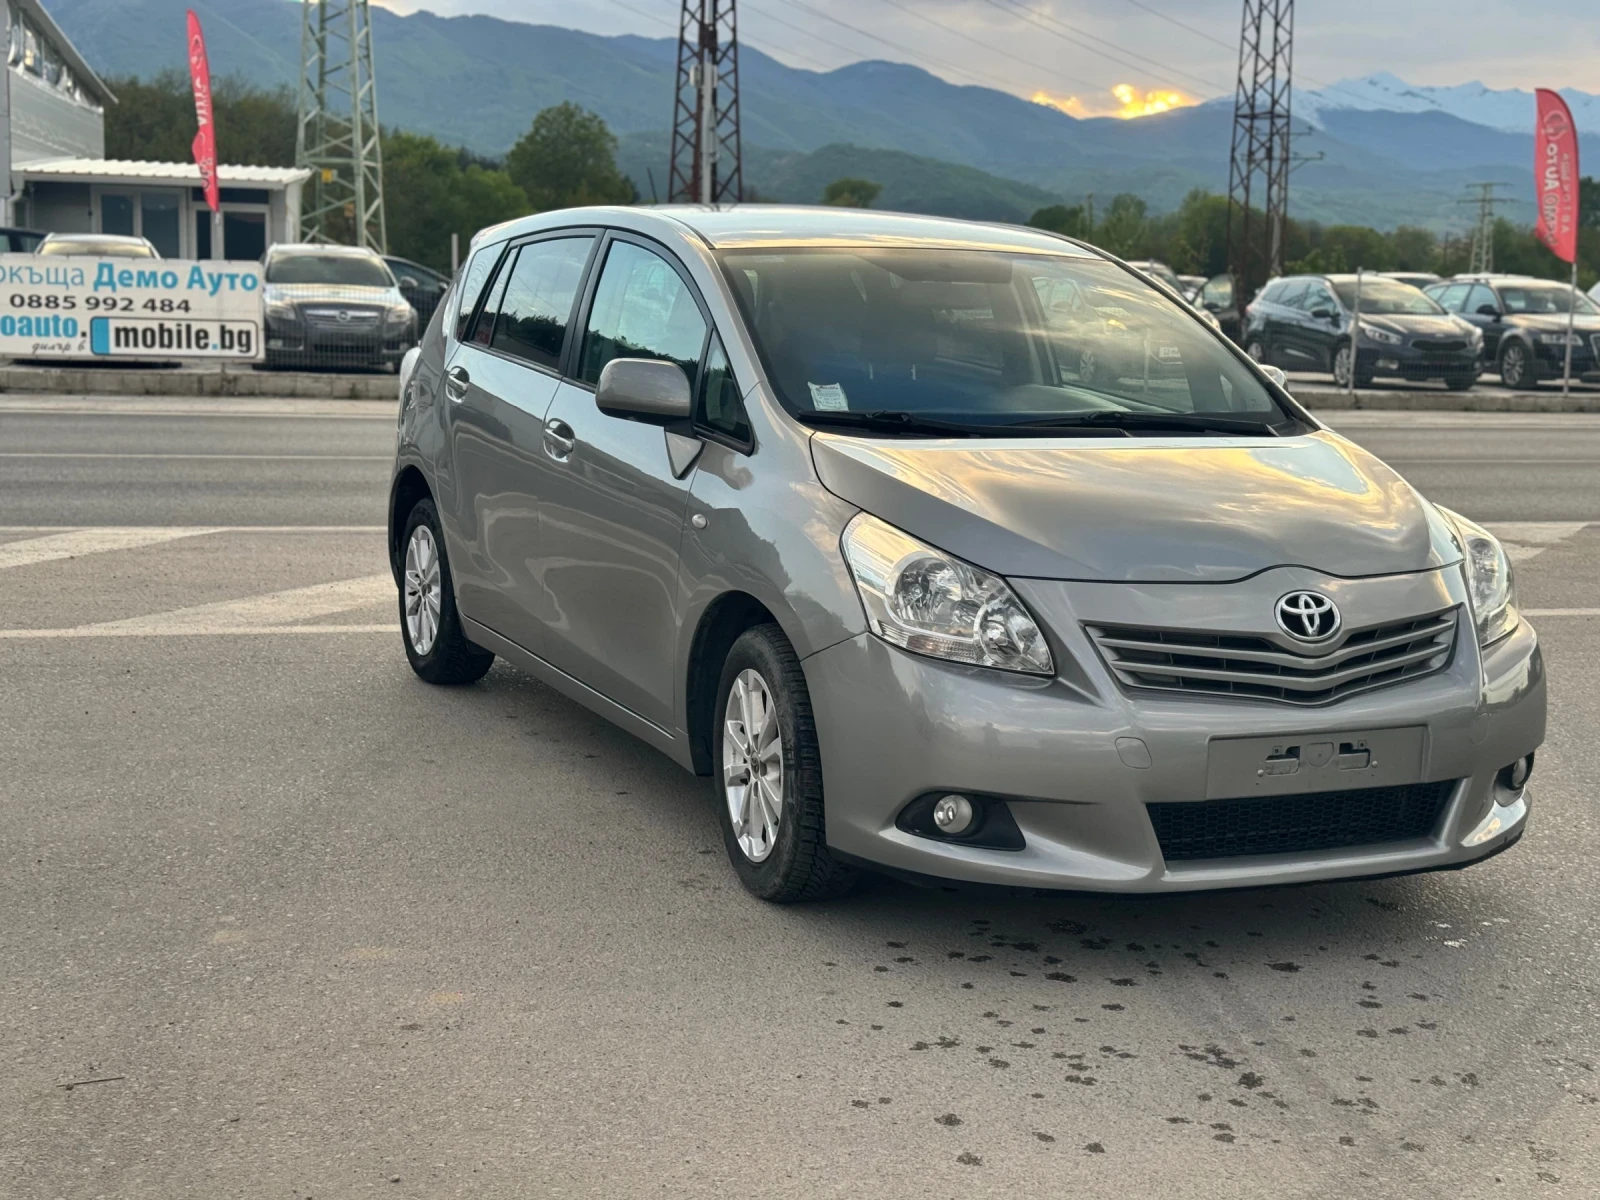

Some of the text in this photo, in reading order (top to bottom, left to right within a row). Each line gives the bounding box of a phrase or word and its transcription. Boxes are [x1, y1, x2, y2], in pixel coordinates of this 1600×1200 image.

[93, 262, 179, 292] Демо
[186, 265, 258, 297] Ауто
[9, 294, 191, 314] 0885 992 484
[114, 322, 252, 353] mobile.bg
